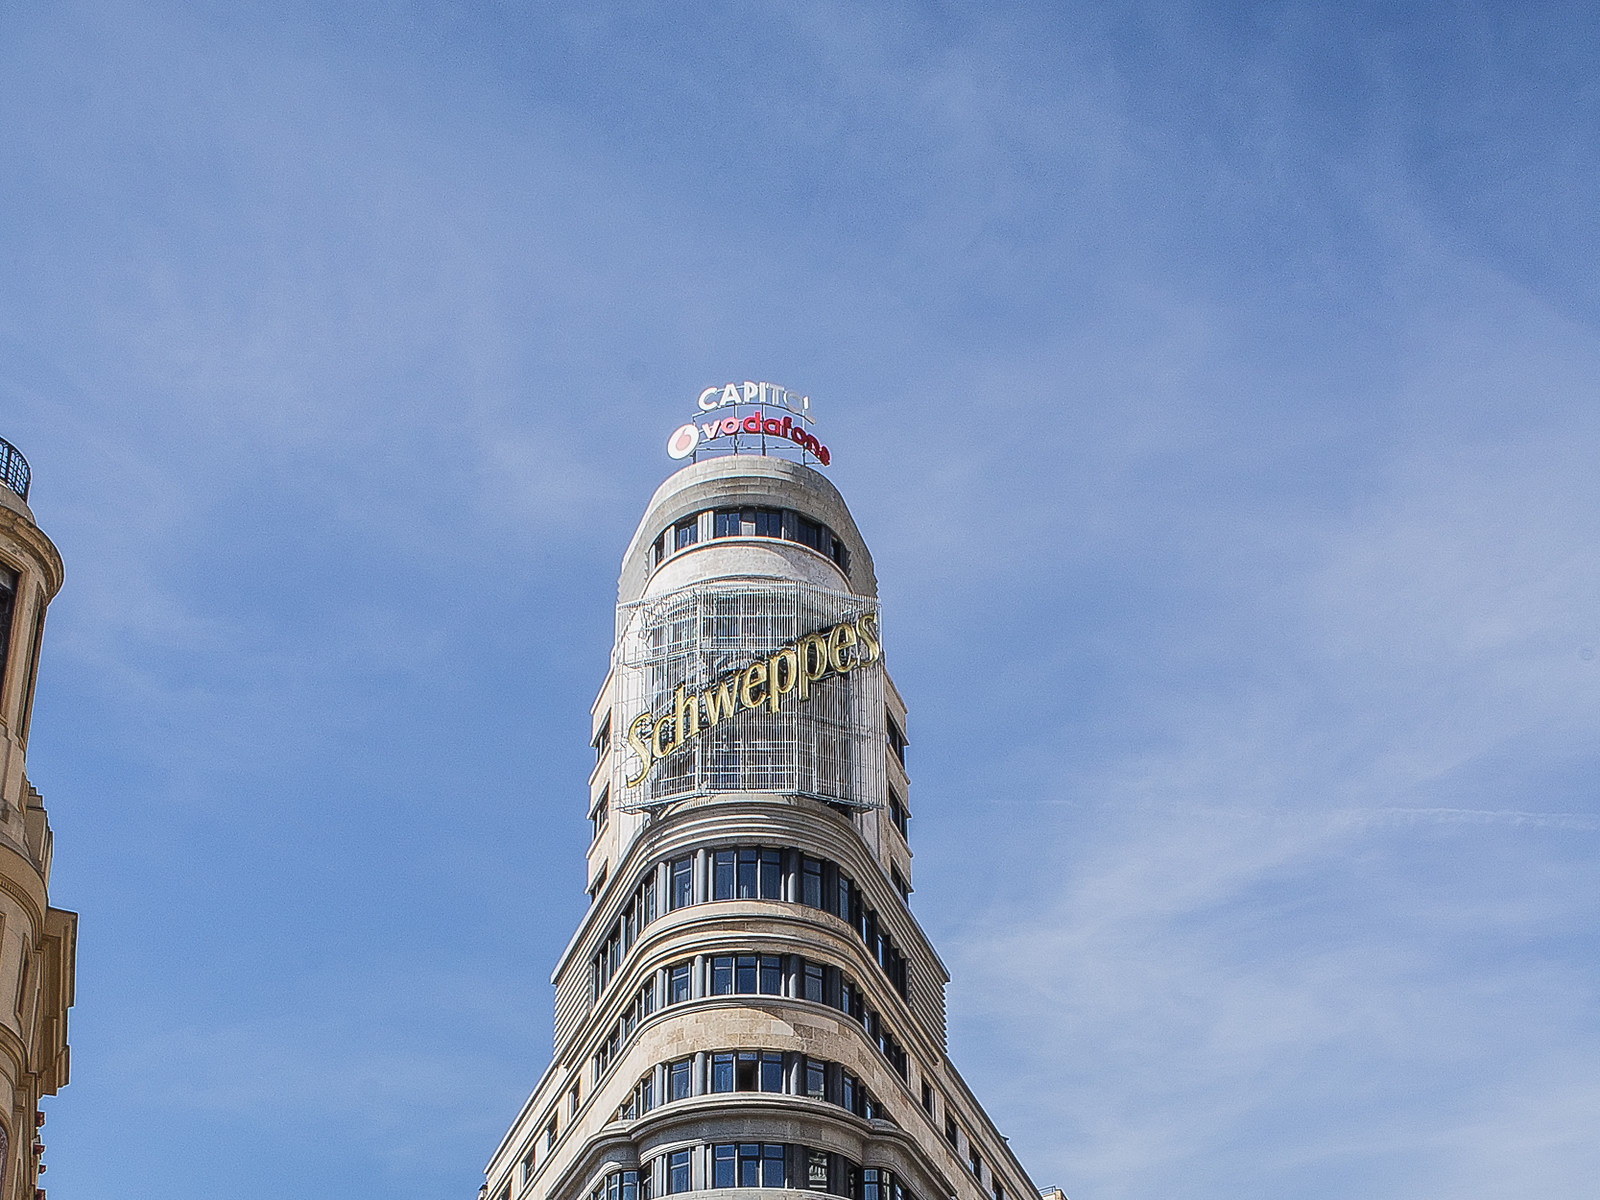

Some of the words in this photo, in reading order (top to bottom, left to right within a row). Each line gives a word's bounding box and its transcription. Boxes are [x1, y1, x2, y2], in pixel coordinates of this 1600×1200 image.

[698, 381, 816, 425] CAPITOL
[702, 411, 830, 466] vodafone
[626, 613, 880, 789] Schweppes
